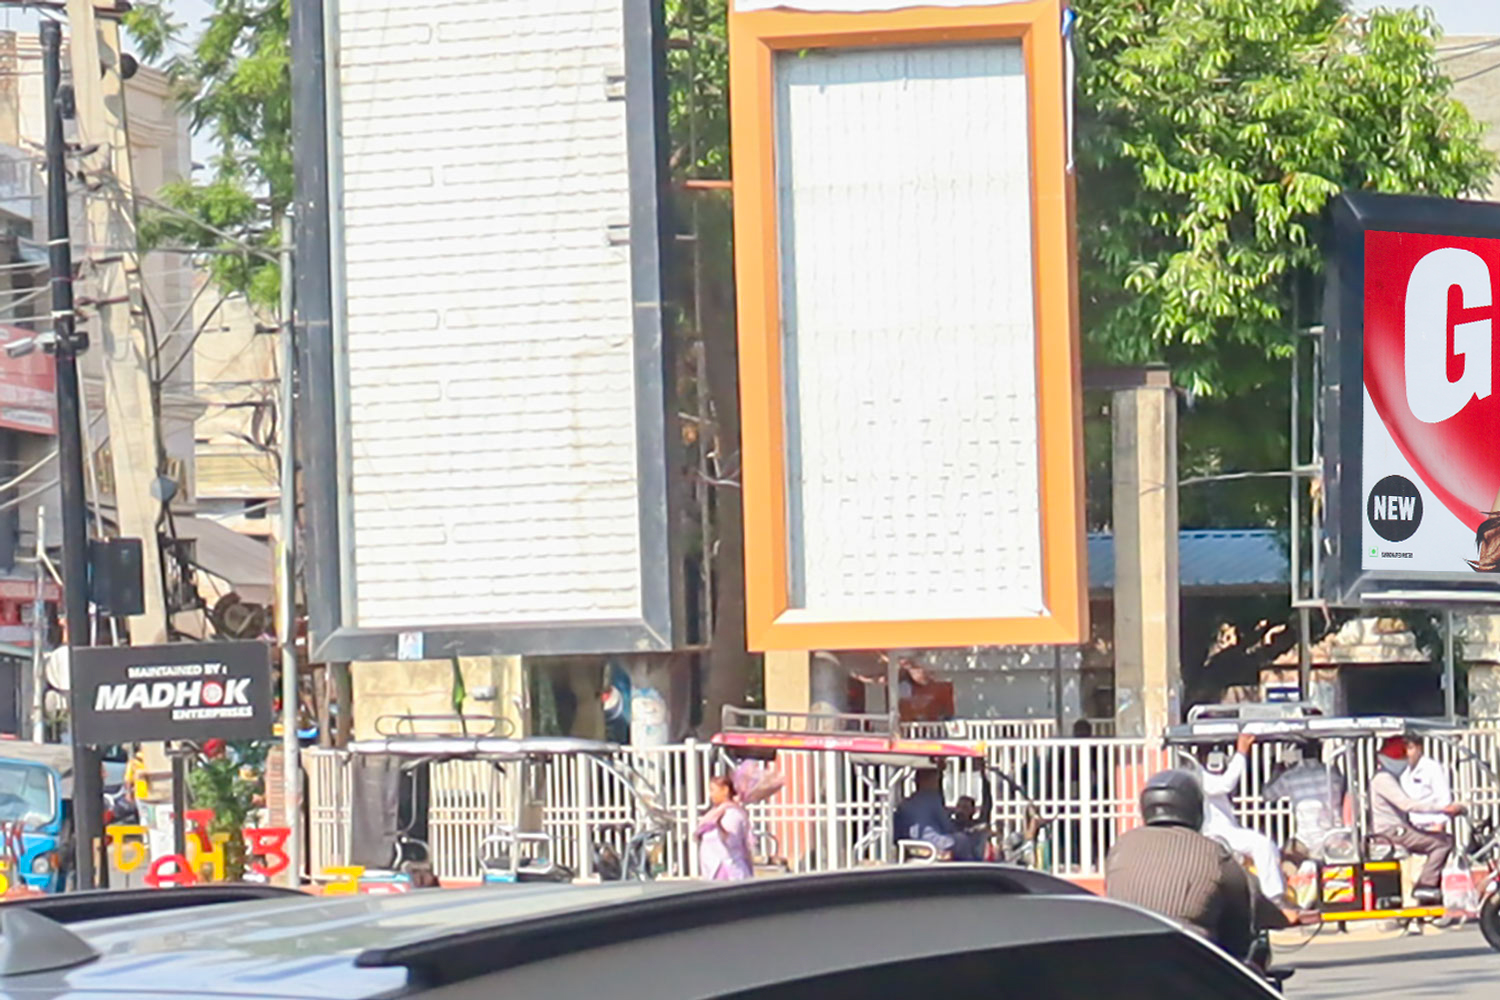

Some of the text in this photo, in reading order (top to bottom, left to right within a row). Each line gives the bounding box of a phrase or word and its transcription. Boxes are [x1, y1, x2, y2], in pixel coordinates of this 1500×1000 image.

[1373, 494, 1417, 521] NEW
[127, 664, 203, 679] MAINTAINED
[94, 677, 252, 712] MADHOK
[172, 705, 254, 721] ENTERPRISES
